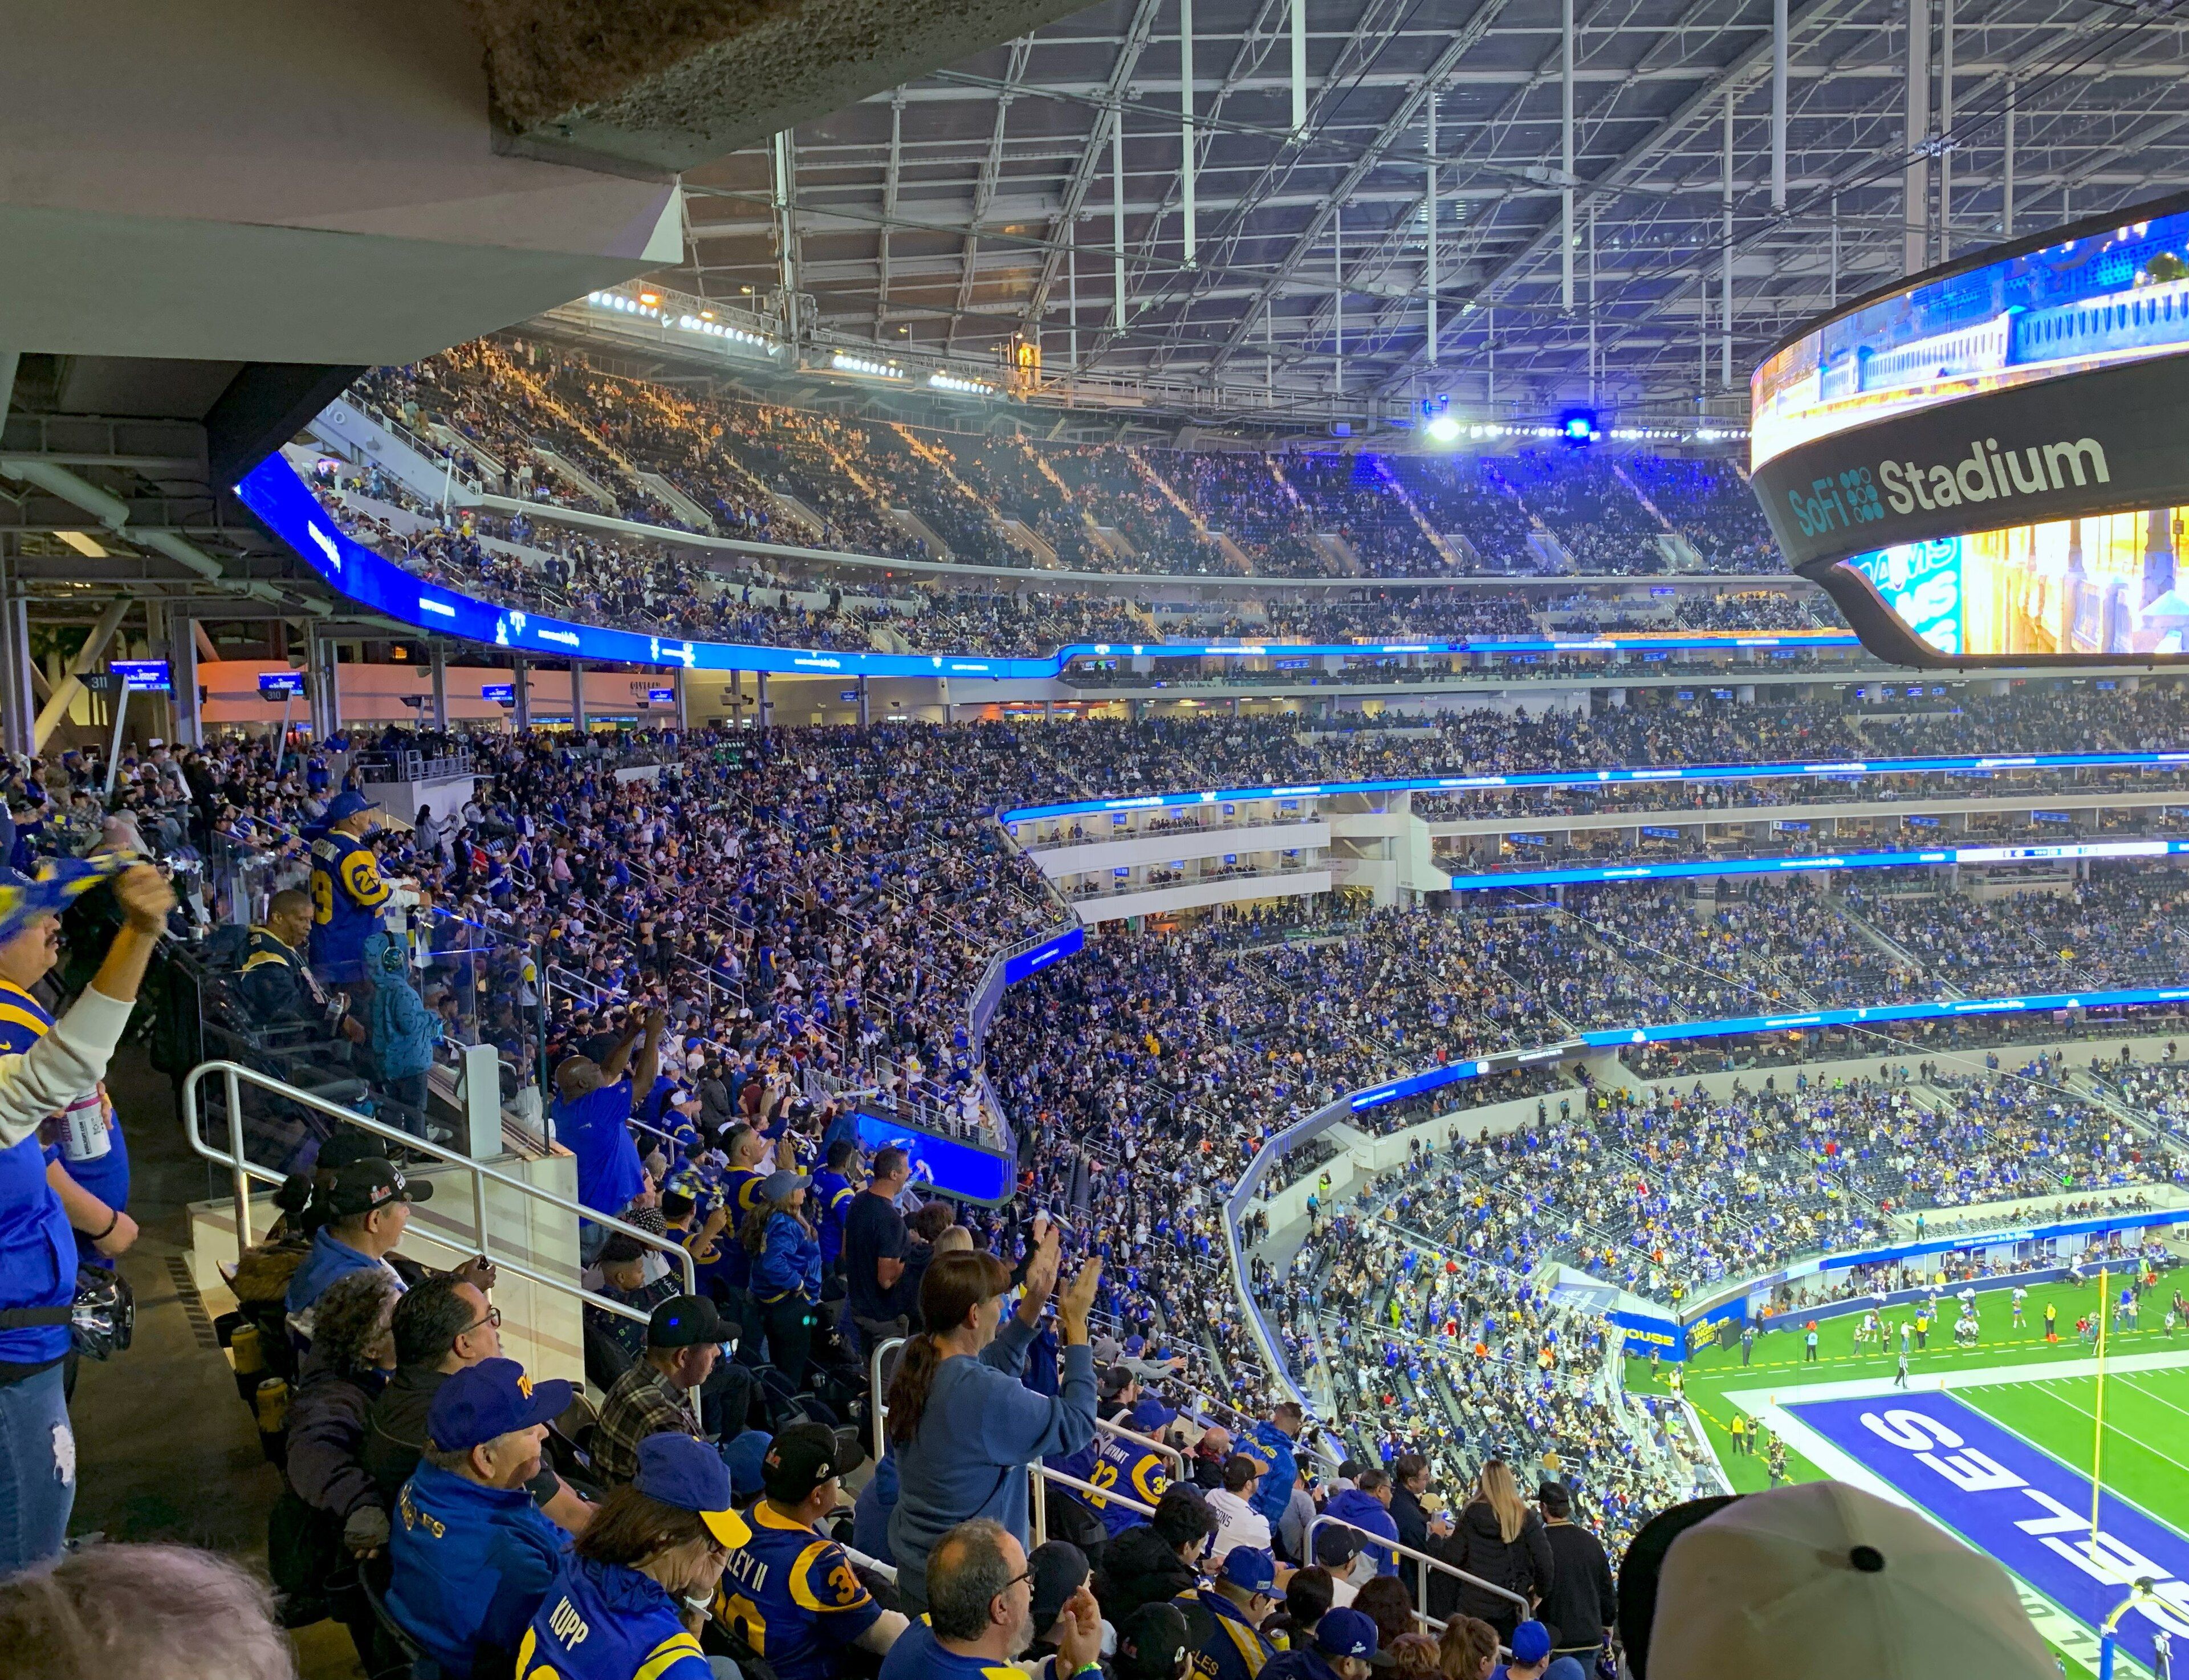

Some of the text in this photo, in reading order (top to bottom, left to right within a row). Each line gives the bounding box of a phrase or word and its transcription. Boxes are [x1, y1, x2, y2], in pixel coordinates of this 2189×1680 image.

[1789, 437, 2110, 537] SoFi Stadium
[91, 677, 108, 689] 311
[355, 867, 381, 893] 29
[1692, 1318, 1708, 1333] LOS
[1216, 1508, 1233, 1528] SONS
[726, 1547, 768, 1592] LEY II
[549, 1596, 589, 1651] KUPP
